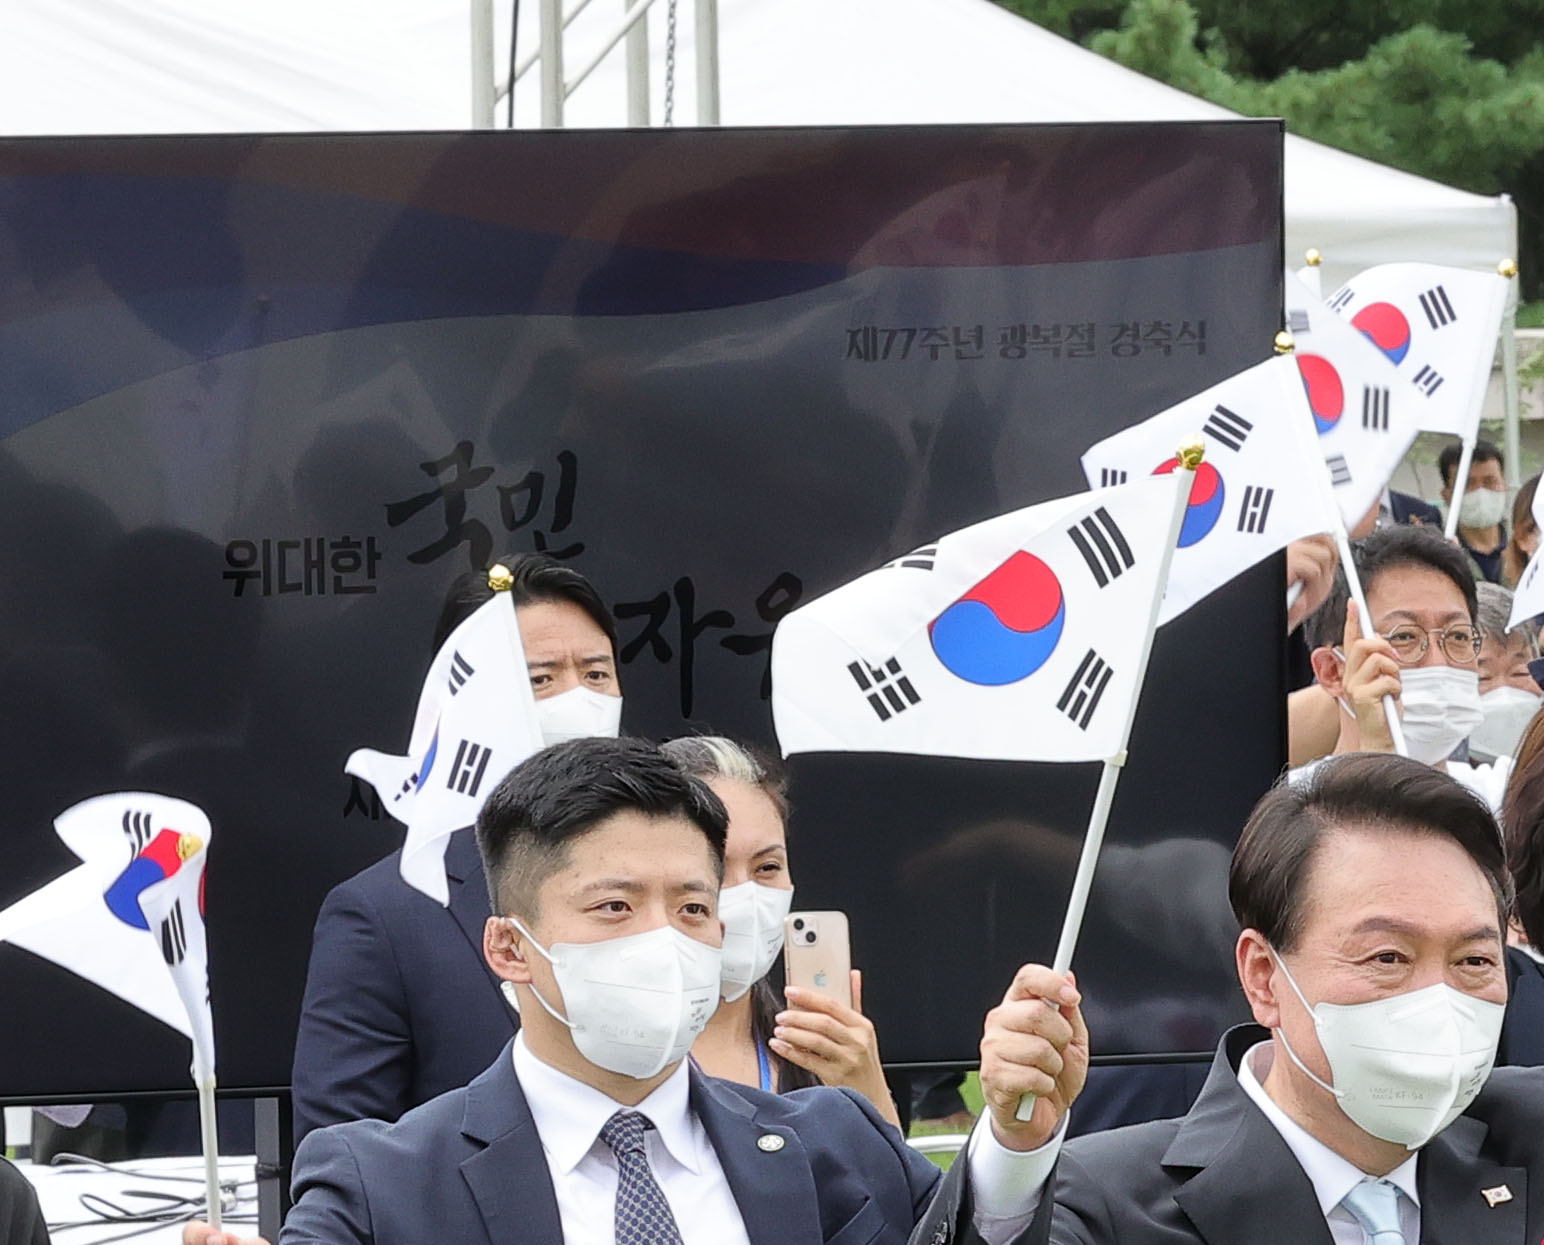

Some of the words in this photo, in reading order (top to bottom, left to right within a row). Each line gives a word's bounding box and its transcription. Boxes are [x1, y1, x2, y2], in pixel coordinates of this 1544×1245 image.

[845, 325, 985, 362] 제77주년
[999, 322, 1097, 360] 광복절
[1110, 319, 1207, 358] 경축식
[222, 535, 382, 597] 위대한
[384, 440, 585, 575] 국민
